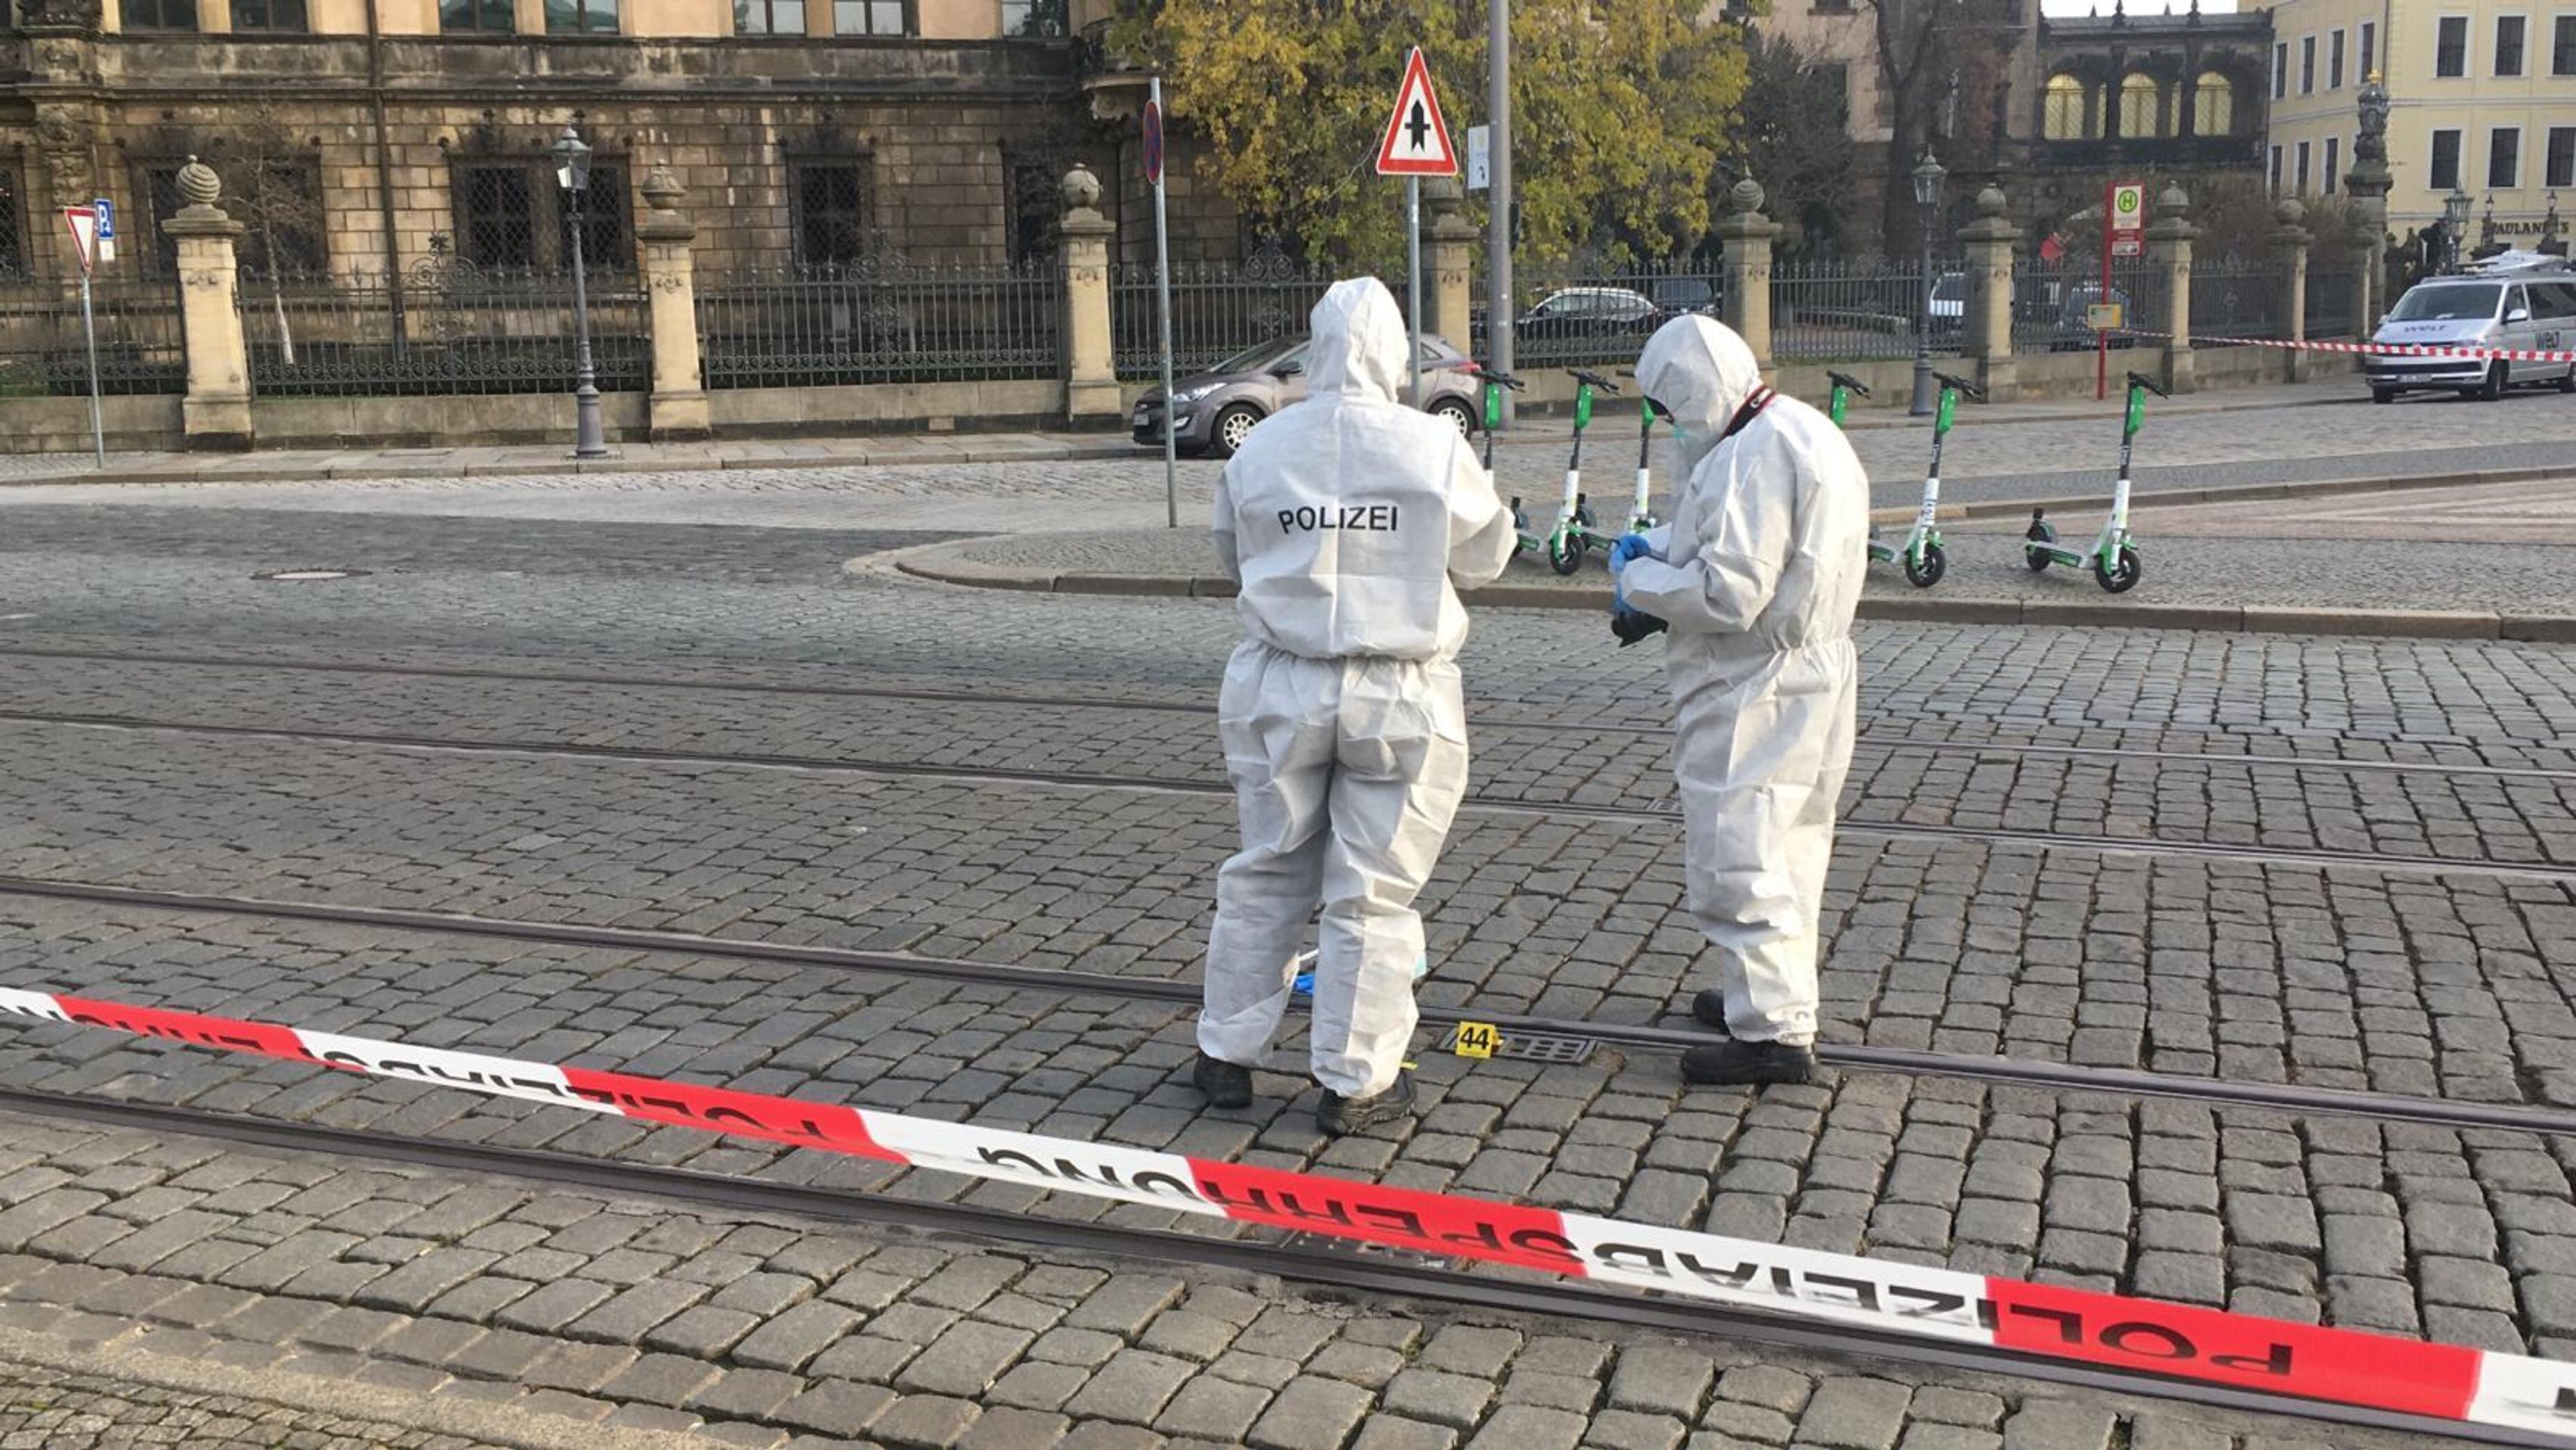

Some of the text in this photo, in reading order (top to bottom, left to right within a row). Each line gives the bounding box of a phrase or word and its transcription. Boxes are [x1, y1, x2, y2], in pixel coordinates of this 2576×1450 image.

[2123, 194, 2133, 208] H
[1277, 505, 1398, 535] POLIZEI
[1459, 1026, 1490, 1050] 44
